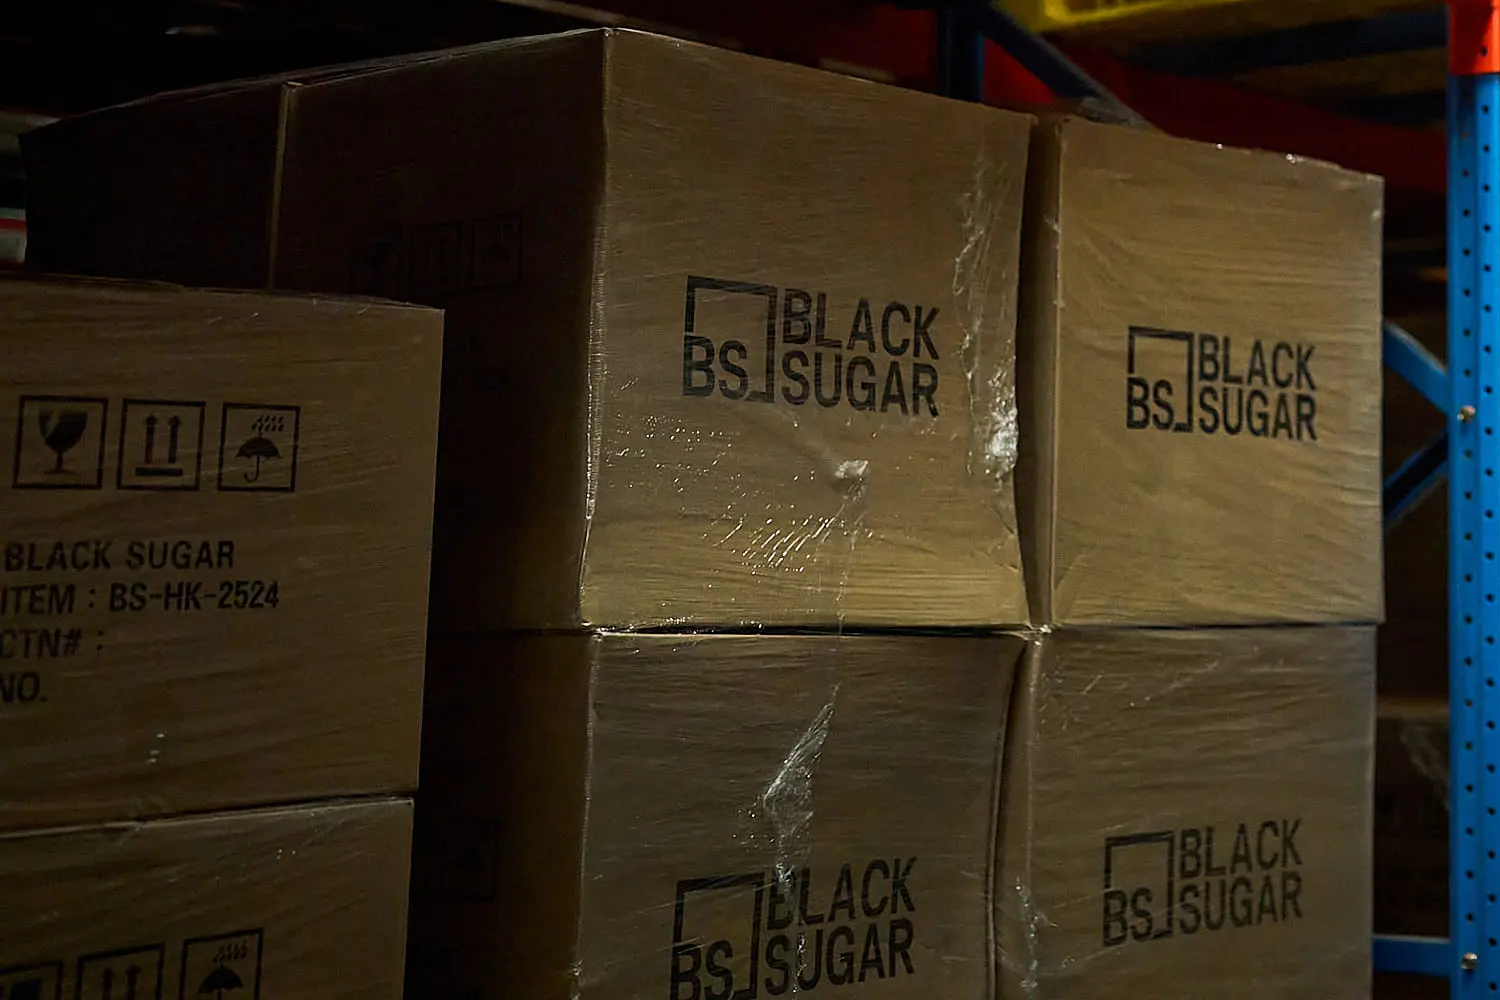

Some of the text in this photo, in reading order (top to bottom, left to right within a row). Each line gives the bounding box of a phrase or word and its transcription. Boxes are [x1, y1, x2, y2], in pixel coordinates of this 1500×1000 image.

[782, 287, 941, 361] BLACK
[780, 350, 940, 418] SUGAR
[1199, 332, 1317, 391] BLACK
[1199, 385, 1318, 442] SUGAR
[5, 540, 235, 571] BLACK SUGAR
[110, 580, 280, 612] BS-HK-2524
[1180, 818, 1303, 879] BLACK
[767, 856, 917, 931] BLACK
[1179, 871, 1303, 935] SUGAR
[765, 918, 915, 996] SUGAR
